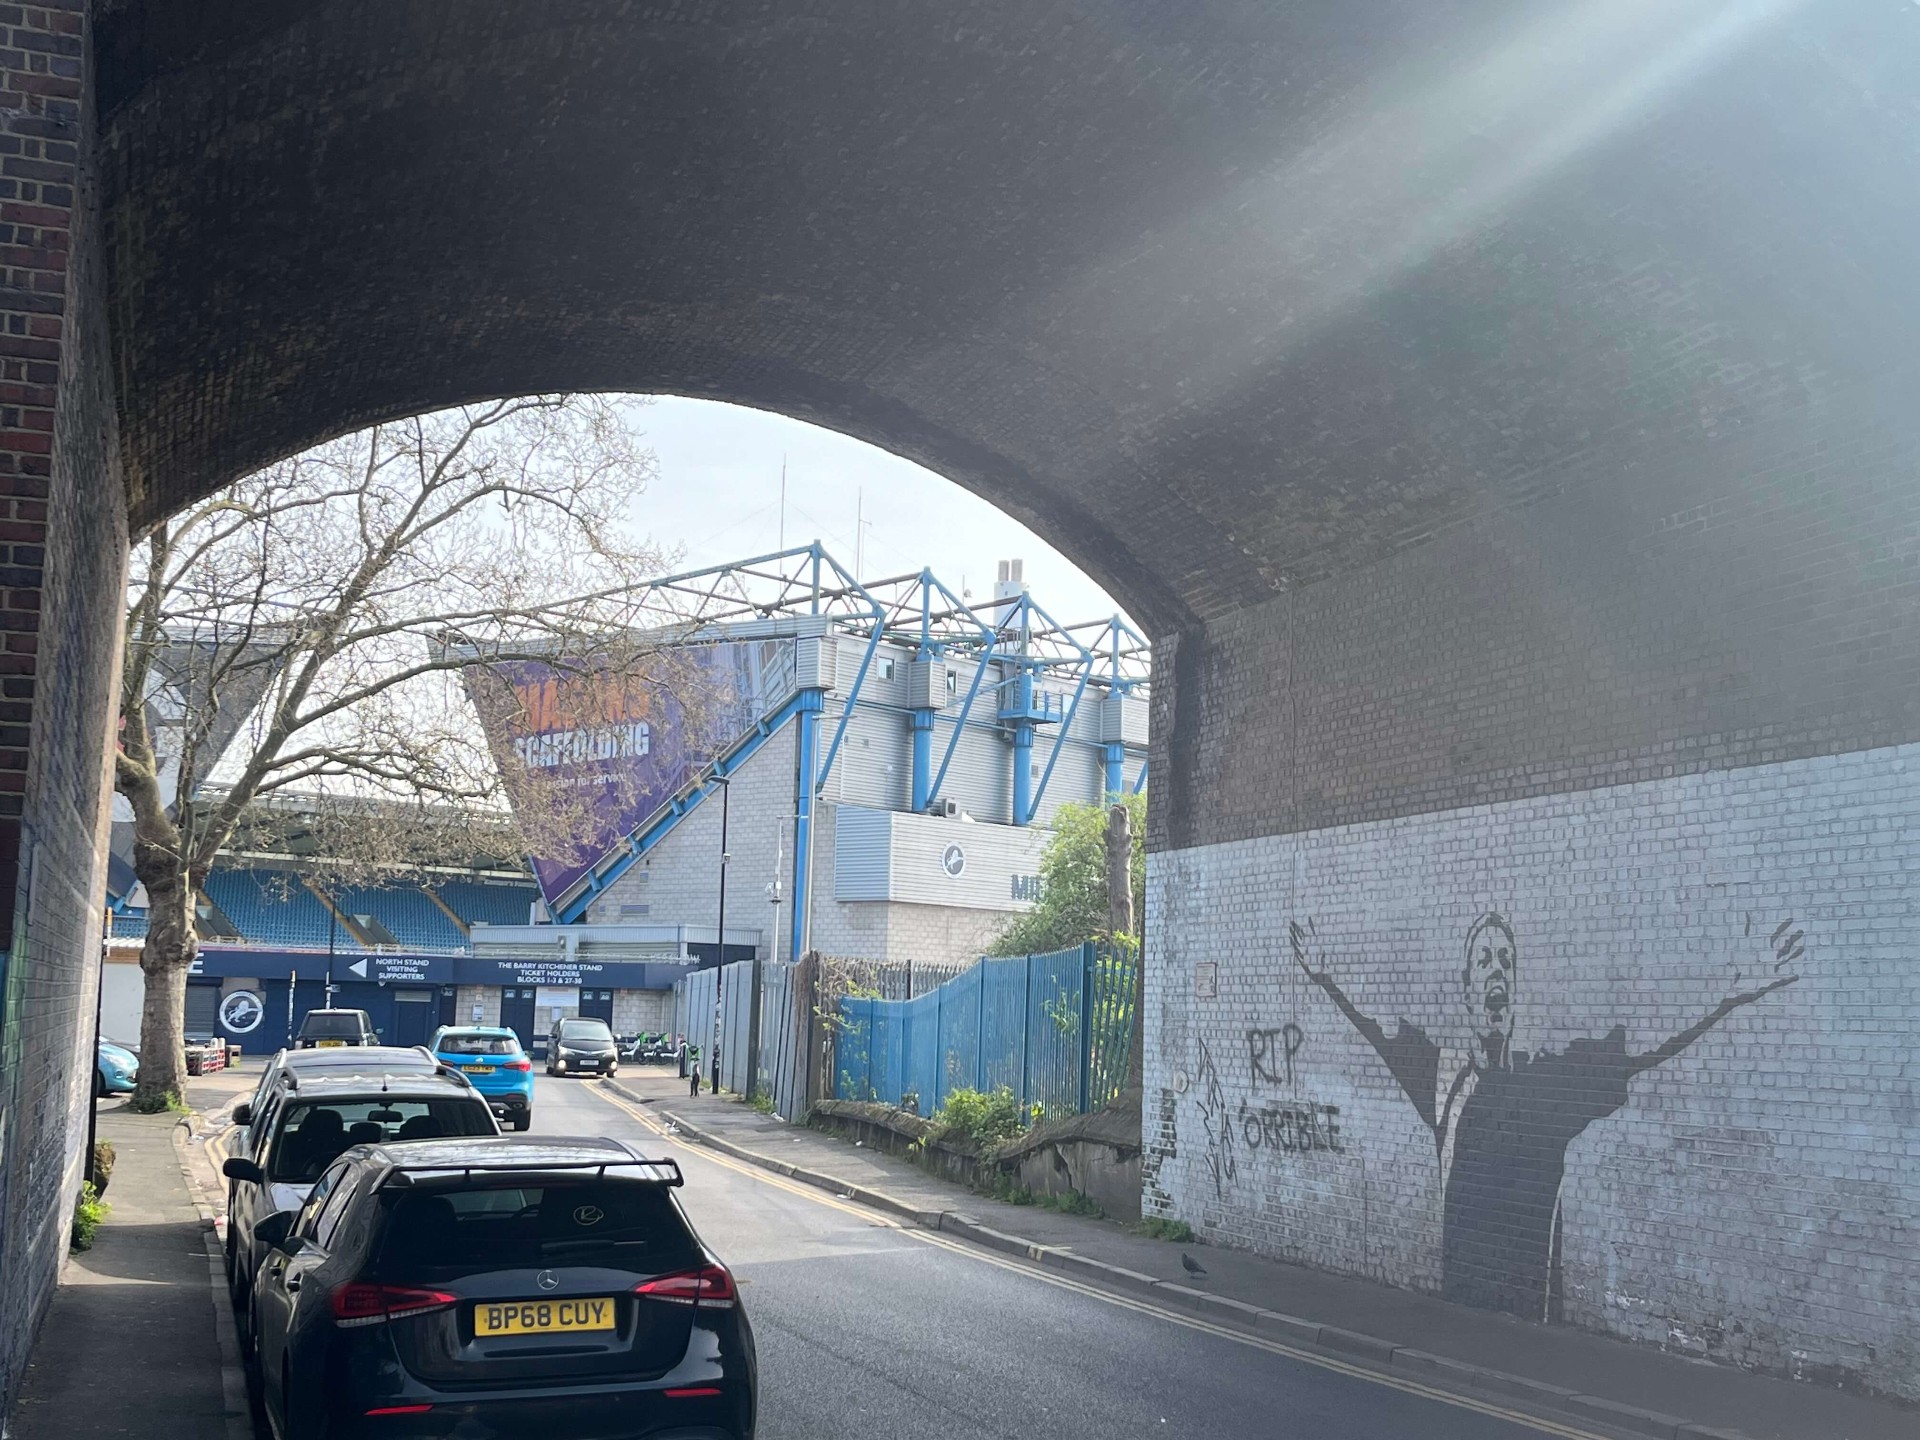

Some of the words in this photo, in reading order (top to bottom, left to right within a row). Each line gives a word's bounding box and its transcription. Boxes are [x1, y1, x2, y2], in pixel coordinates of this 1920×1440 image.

[375, 958, 403, 966] NORTH
[404, 959, 430, 967] STAND
[513, 962, 537, 970] BARRY
[537, 963, 578, 971] KITCHENER
[386, 965, 419, 973] VISITING
[520, 969, 545, 977] TICKET
[547, 970, 580, 978] HOLDERS
[378, 972, 425, 980] SUPPORTERS
[517, 976, 545, 984] BLOCKS
[558, 977, 564, 985] &
[564, 977, 582, 985] 27-30
[1246, 1024, 1303, 1095] RIP
[488, 1305, 552, 1330] BP68
[559, 1301, 605, 1326] CUY
